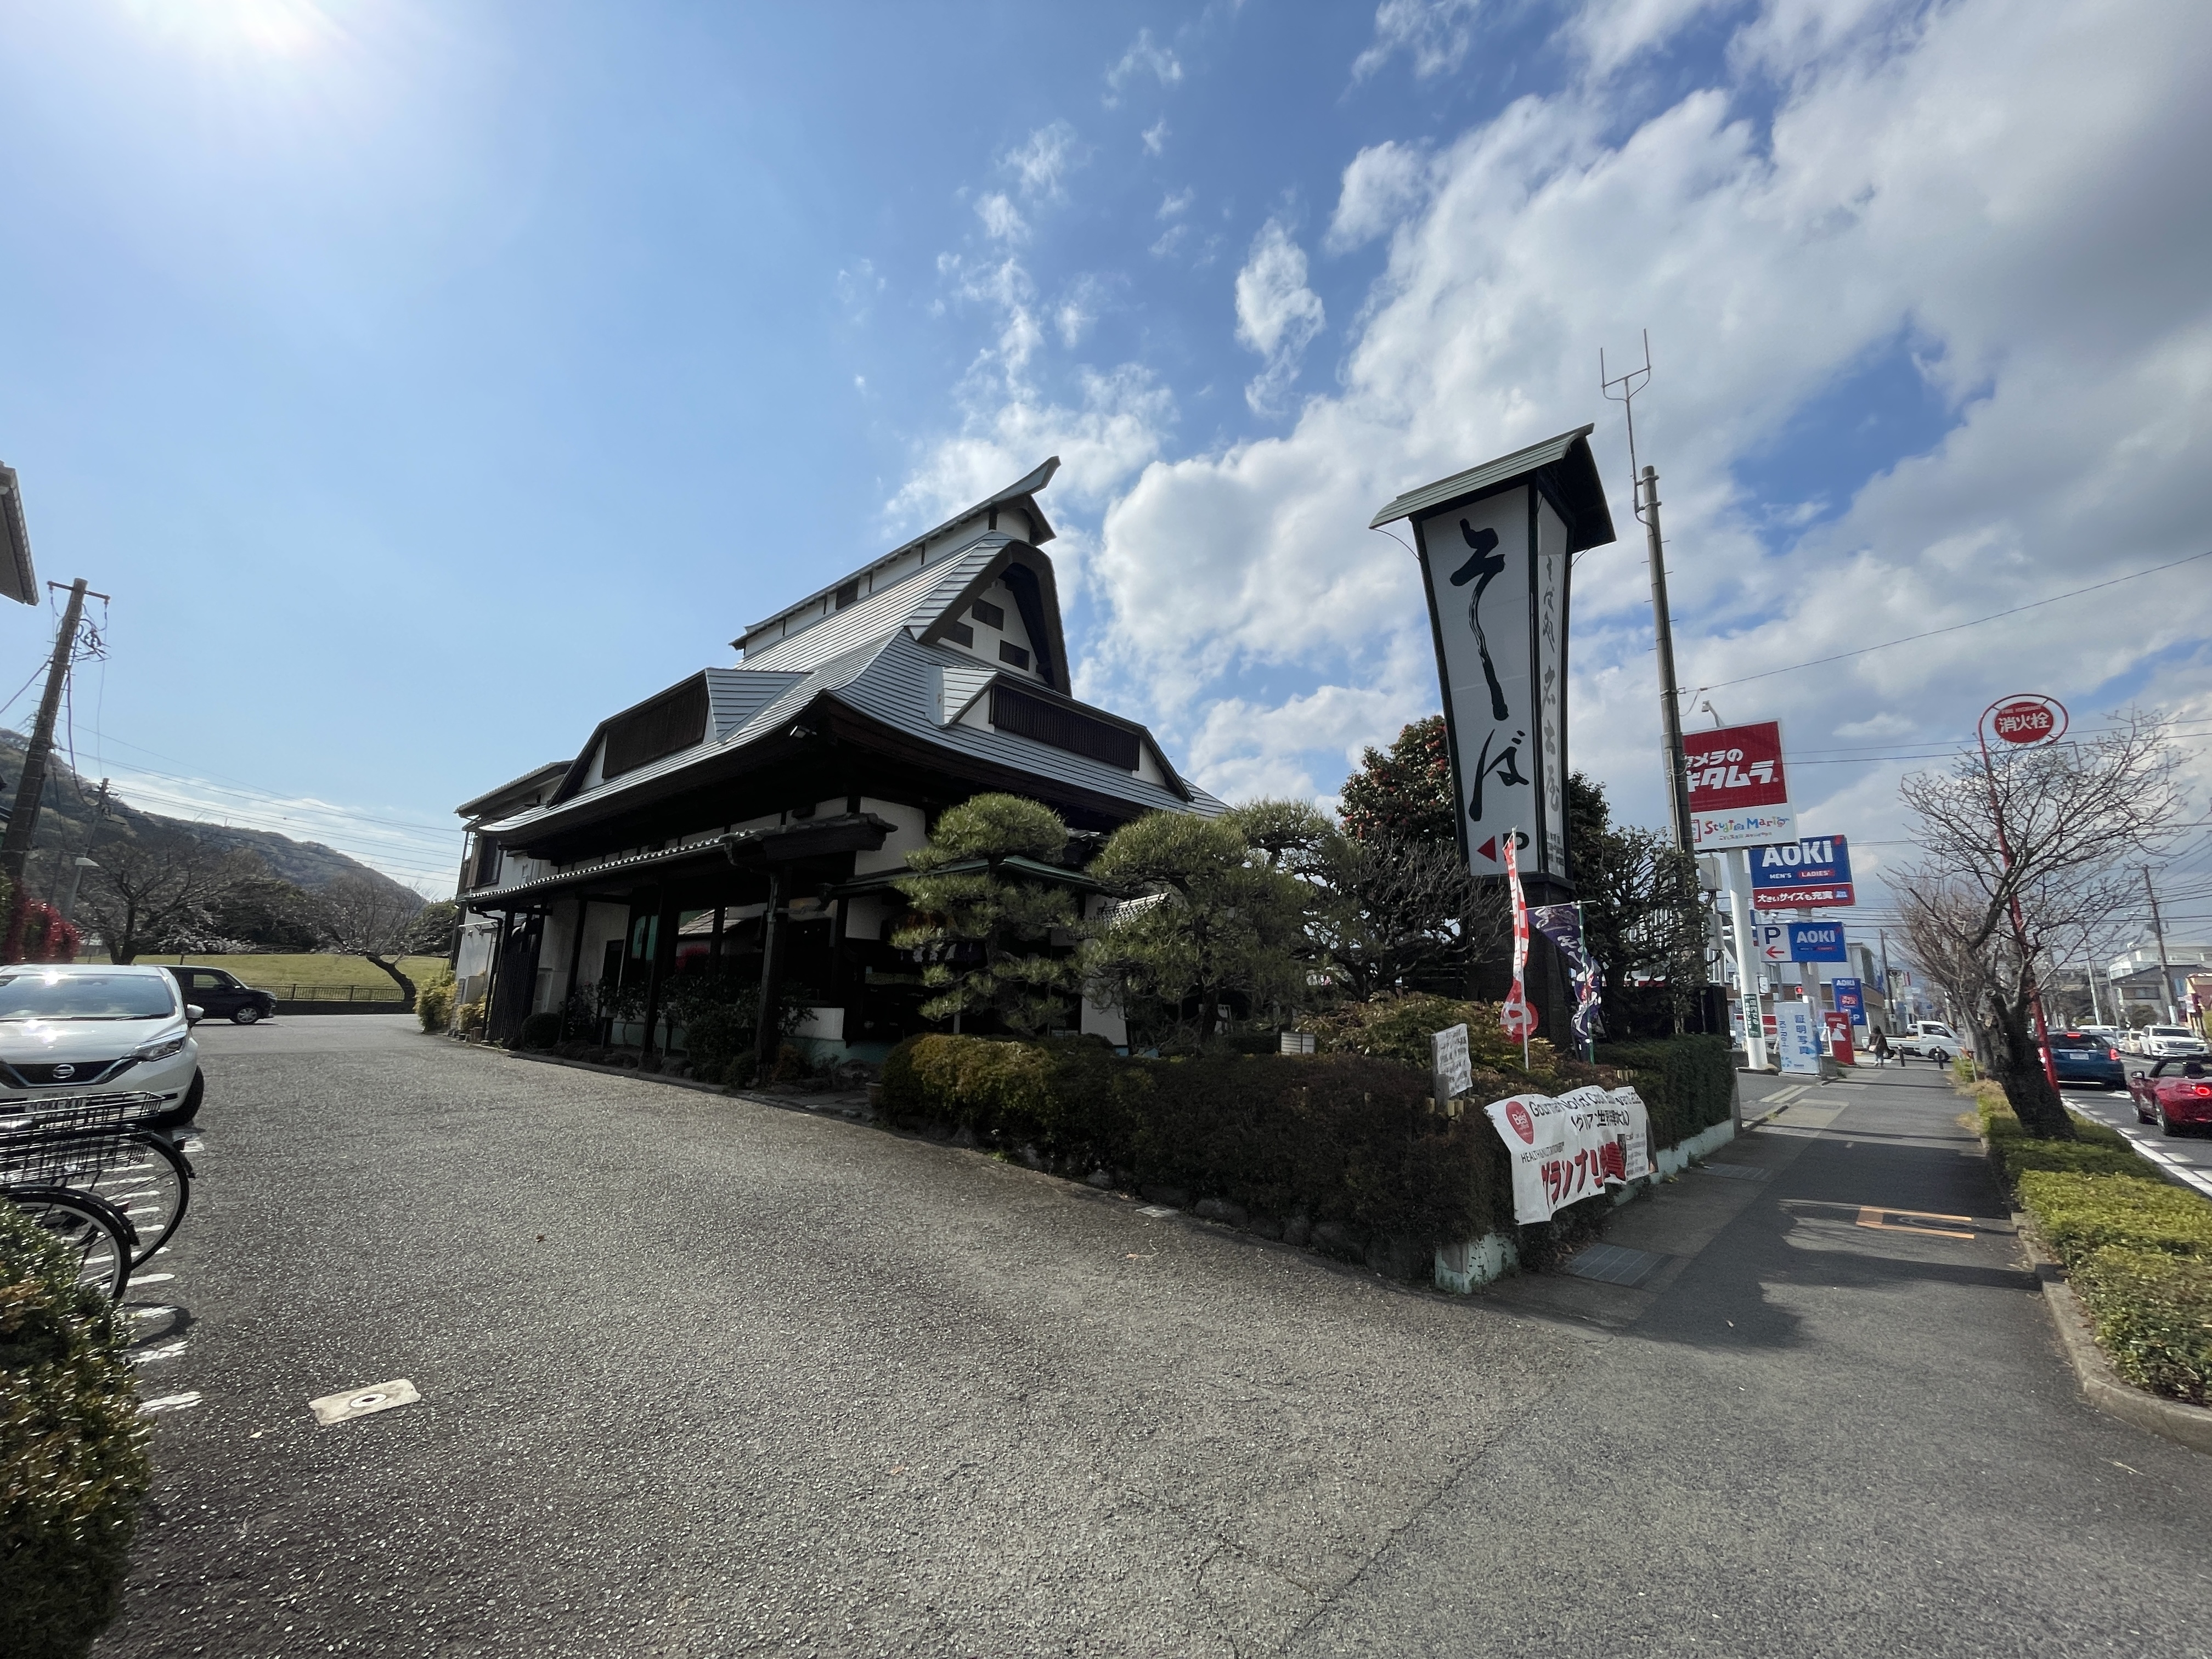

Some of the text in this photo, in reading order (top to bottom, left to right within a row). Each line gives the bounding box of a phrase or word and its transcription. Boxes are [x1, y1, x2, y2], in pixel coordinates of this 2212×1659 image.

[1450, 518, 1530, 822] そば
[1998, 712, 2051, 733] 消火栓
[1762, 840, 1834, 867] AOKI
[1757, 890, 1834, 903] 大きいサイズも充実
[1764, 927, 1781, 945] P
[1796, 930, 1836, 944] AOKI
